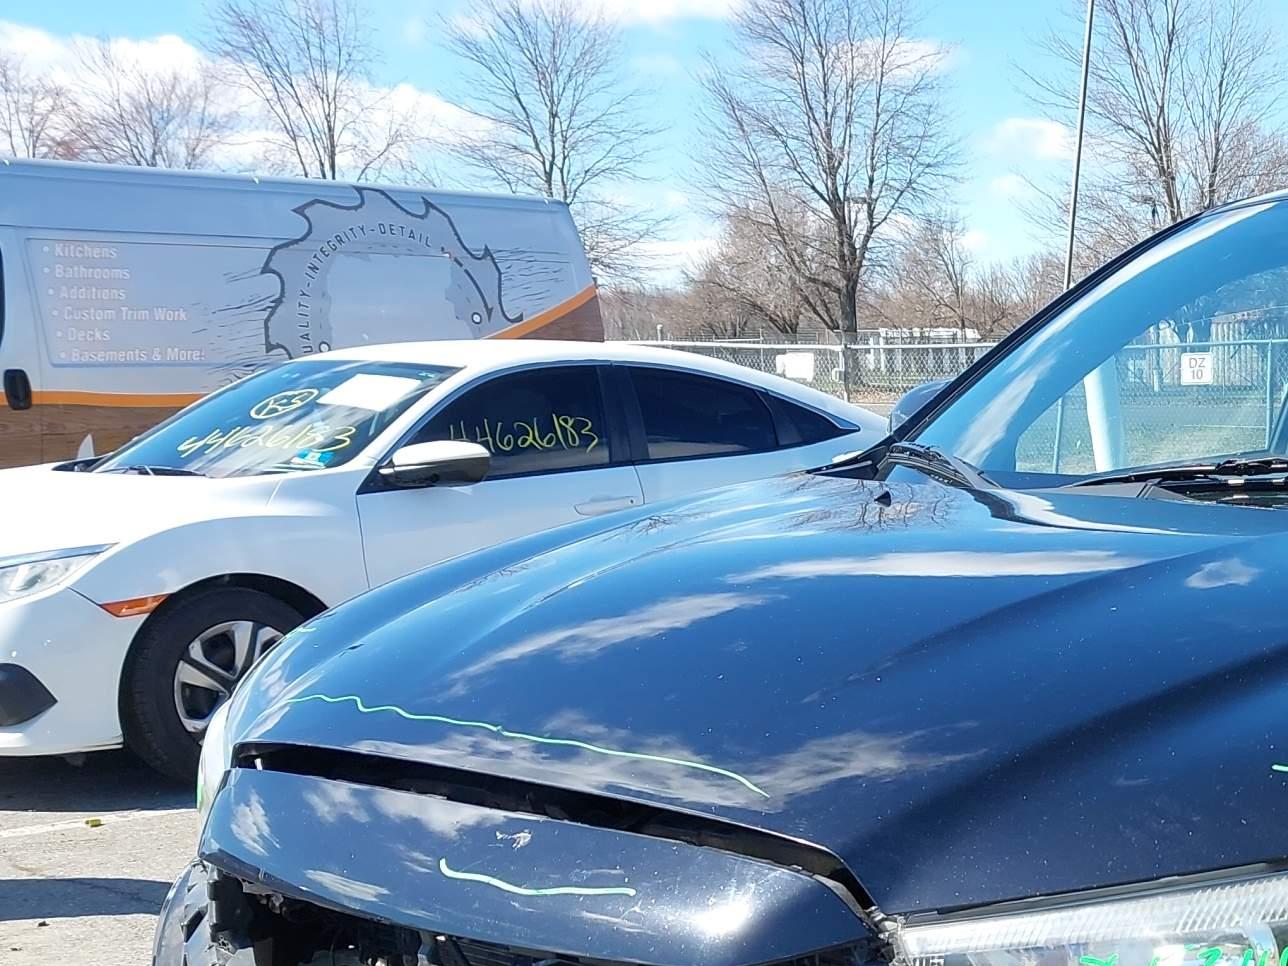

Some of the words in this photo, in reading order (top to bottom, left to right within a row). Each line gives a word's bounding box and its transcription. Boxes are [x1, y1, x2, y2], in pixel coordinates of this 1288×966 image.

[55, 243, 118, 259] Kitchens
[55, 264, 131, 280] Bathrooms
[59, 285, 127, 300] Additions
[297, 222, 431, 354] UALITY-INTEGRITY-DETAIL
[64, 306, 116, 321] Custom
[120, 306, 150, 321] Trim
[153, 306, 188, 321] Work
[68, 327, 111, 342] Decks
[71, 347, 148, 362] Basements
[151, 347, 162, 362] &
[1188, 357, 1206, 369] DZ
[1191, 369, 1204, 380] 10
[177, 424, 356, 458] 44626183
[450, 413, 599, 454] 44626183
